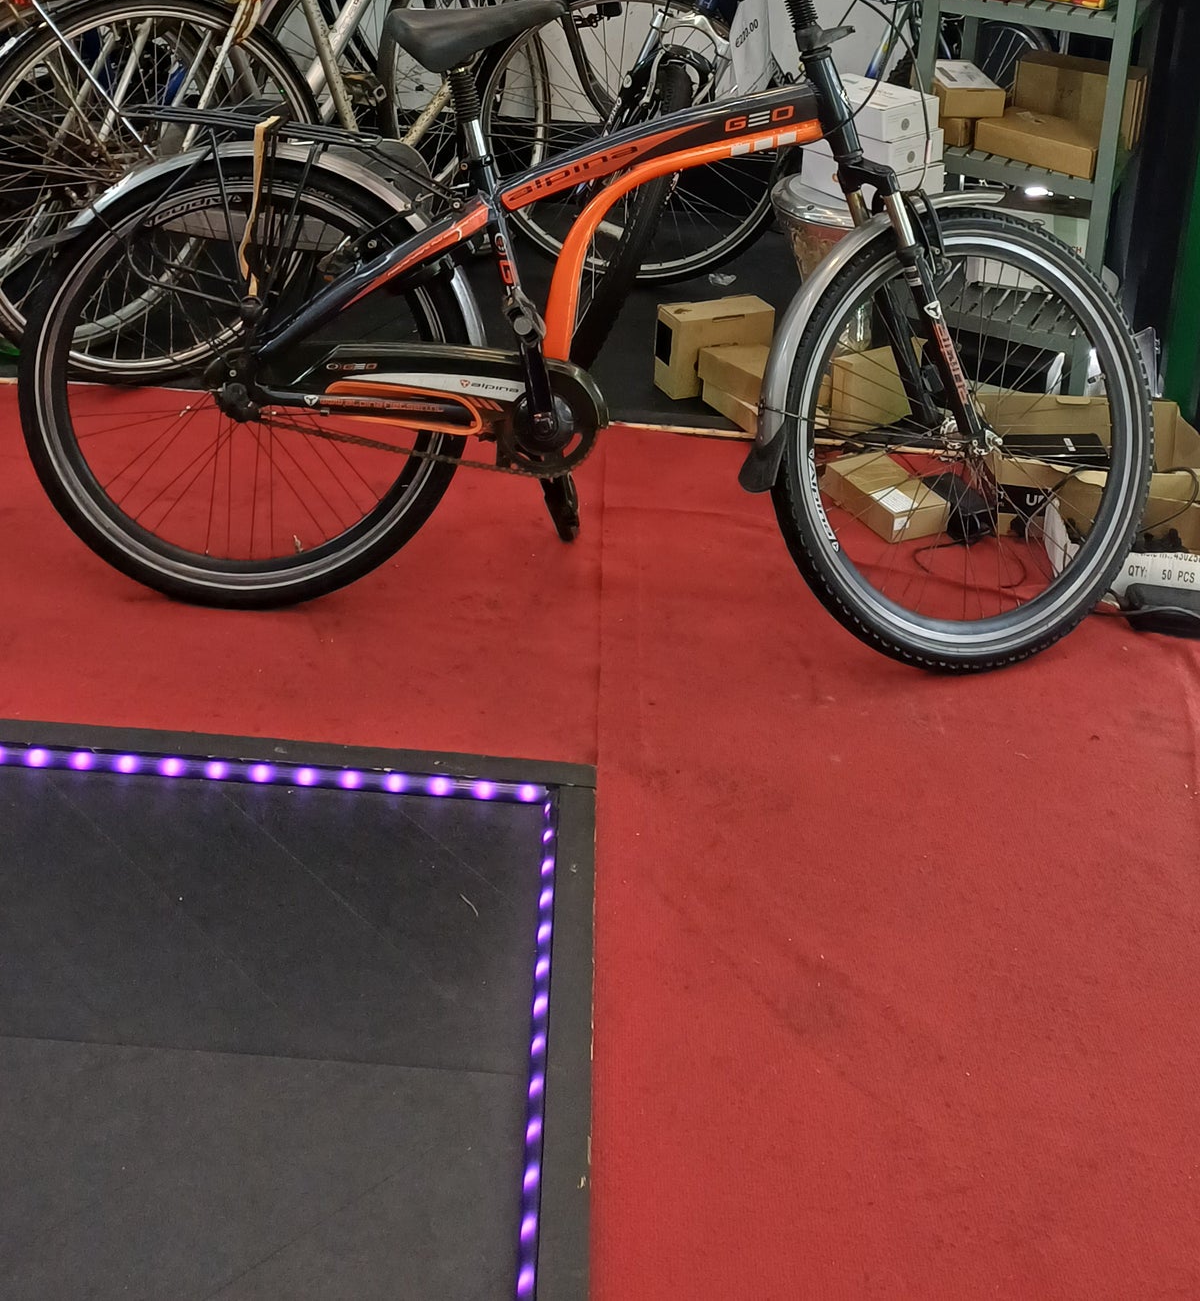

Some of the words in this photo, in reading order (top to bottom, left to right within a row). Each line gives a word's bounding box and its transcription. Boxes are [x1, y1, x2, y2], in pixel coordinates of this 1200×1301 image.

[724, 105, 795, 132] GEO
[507, 146, 639, 202] alpina
[470, 382, 520, 394] alpina
[1161, 569, 1172, 581] 50
[1177, 570, 1196, 584] PCS
